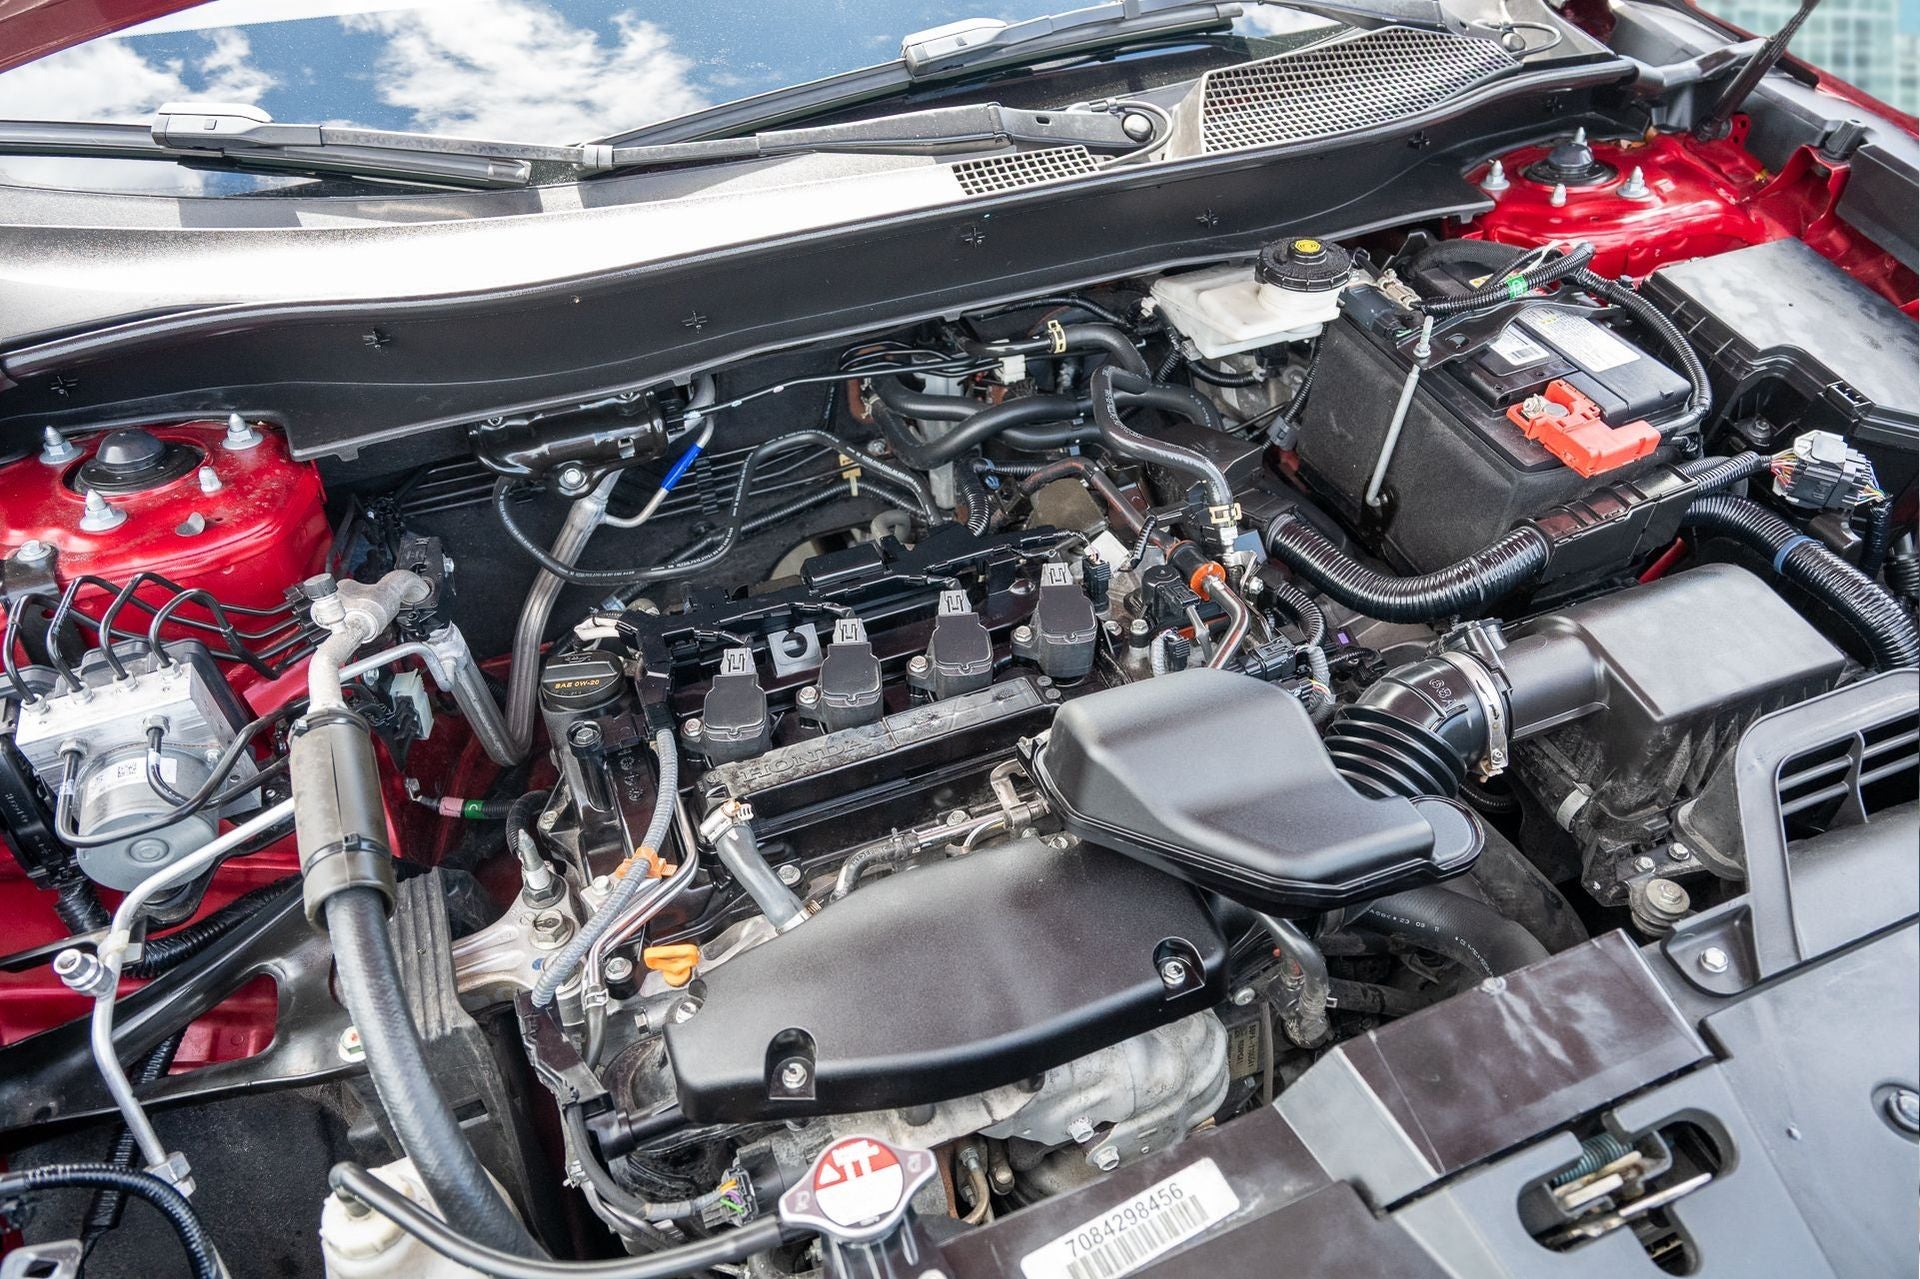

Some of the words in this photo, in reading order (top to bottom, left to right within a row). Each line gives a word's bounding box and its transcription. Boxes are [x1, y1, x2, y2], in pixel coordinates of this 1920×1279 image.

[555, 682, 573, 690] SAE
[574, 679, 600, 688] 0W-20
[739, 740, 873, 783] HONDA
[1064, 1182, 1184, 1257] 7084298456
